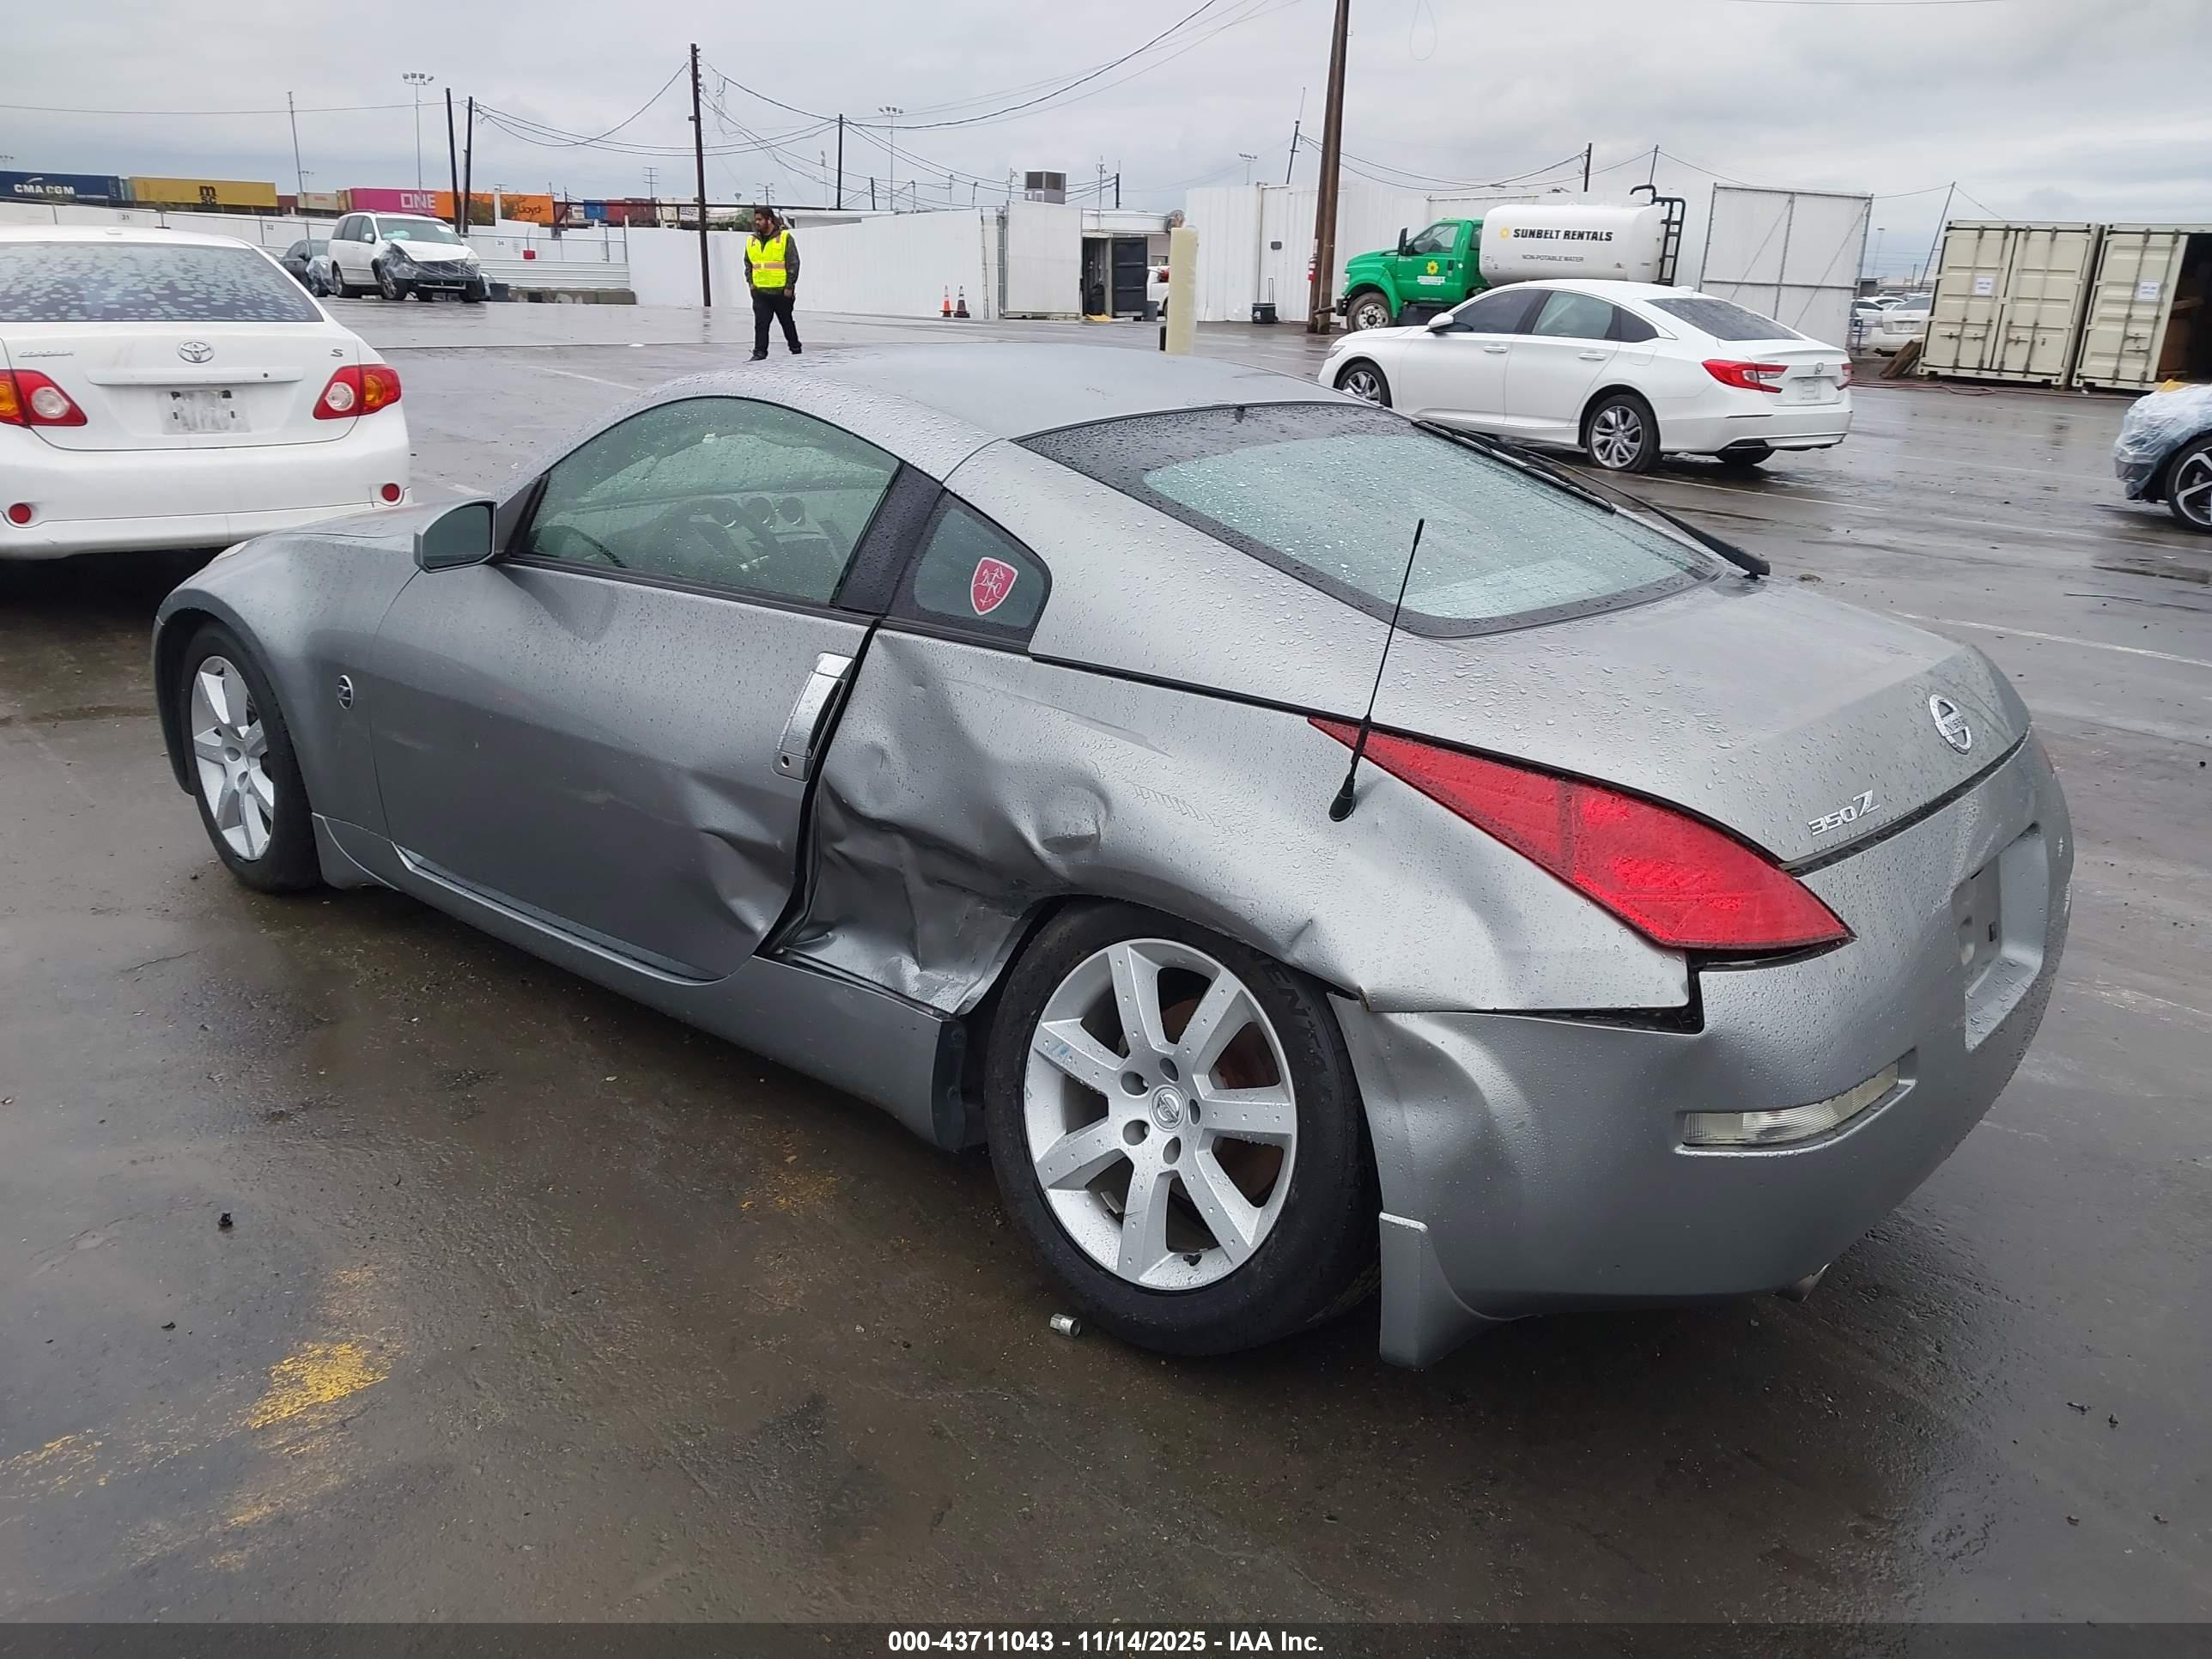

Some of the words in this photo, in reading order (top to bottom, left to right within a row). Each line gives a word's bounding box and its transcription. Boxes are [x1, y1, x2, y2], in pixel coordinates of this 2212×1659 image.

[14, 184, 44, 193] CMA
[46, 185, 76, 195] CGM
[400, 193, 436, 209] ONE
[1513, 228, 1561, 240] SUNBELT
[1563, 230, 1613, 241] RENTALS
[331, 349, 343, 357] S
[1807, 789, 1881, 836] 350Z
